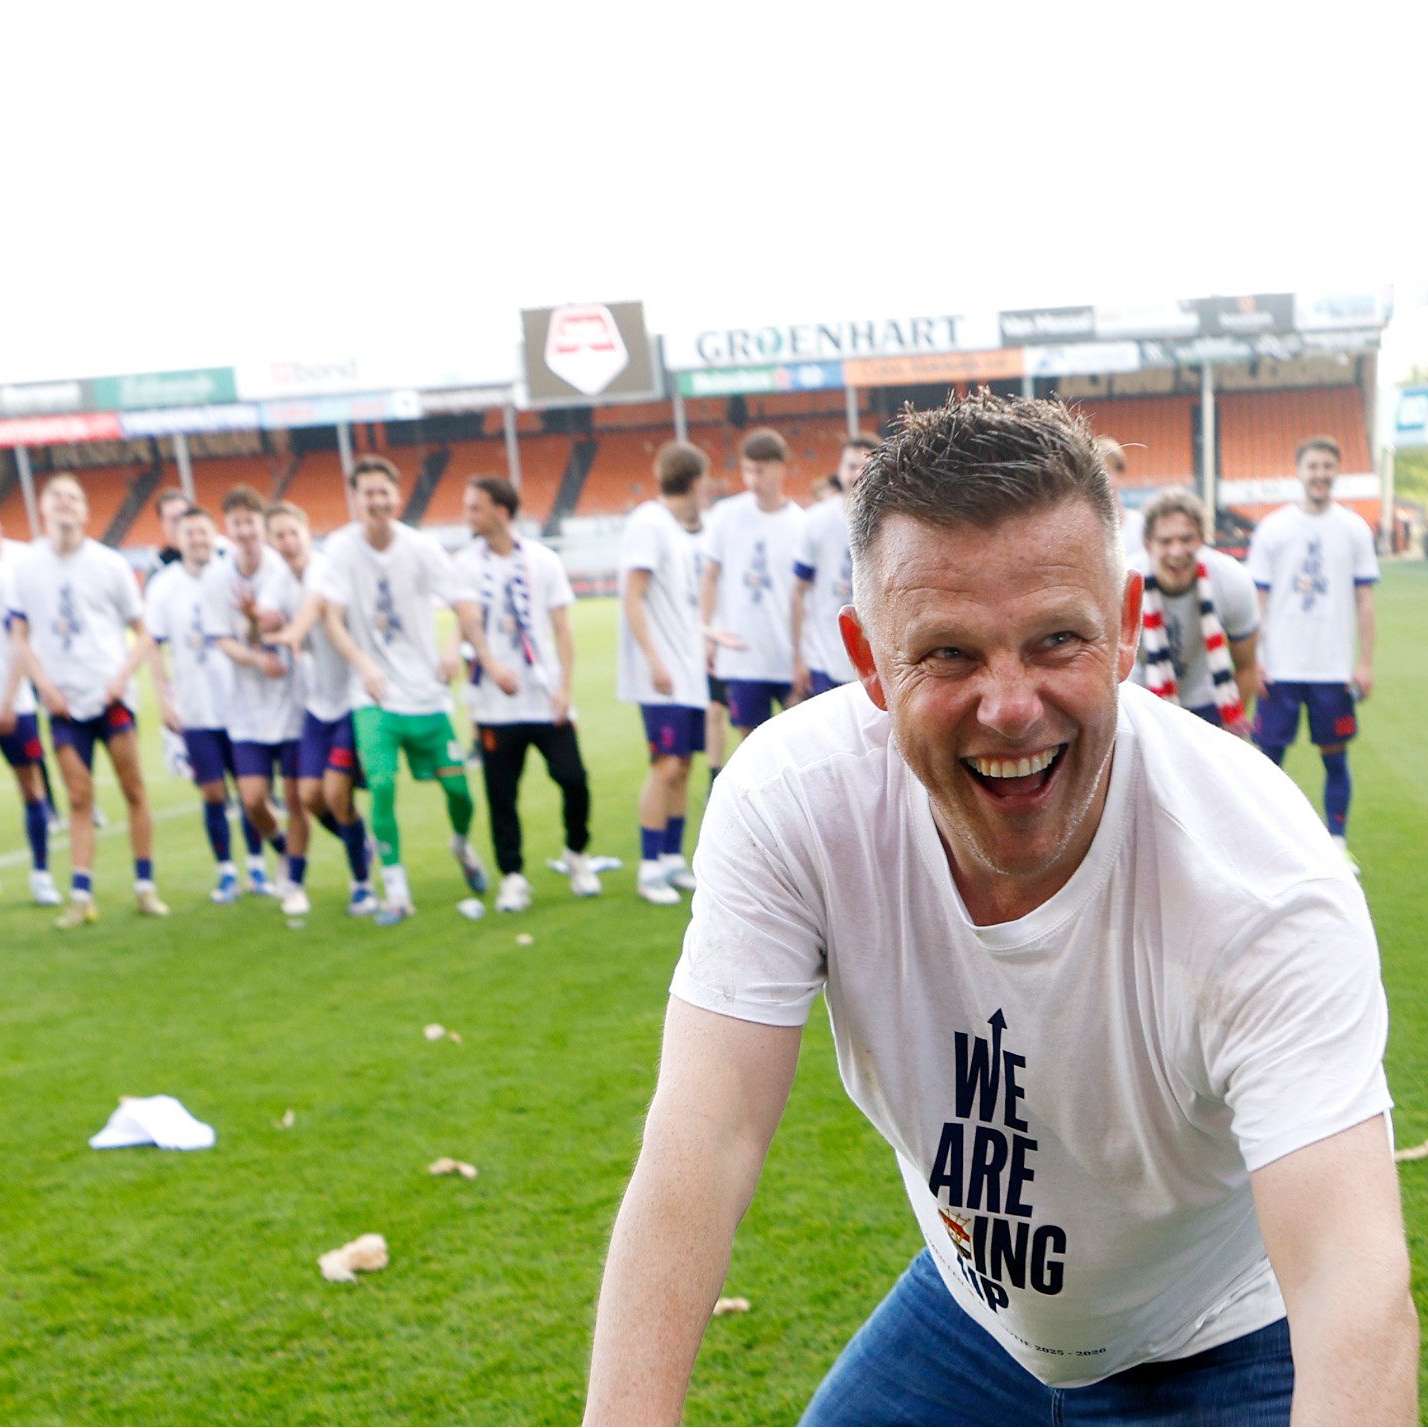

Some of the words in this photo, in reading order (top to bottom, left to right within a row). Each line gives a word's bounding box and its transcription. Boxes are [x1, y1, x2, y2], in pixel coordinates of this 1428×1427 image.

[695, 314, 964, 362] GROENHART
[954, 1010, 1028, 1133] WE
[929, 1122, 1039, 1219] ARE
